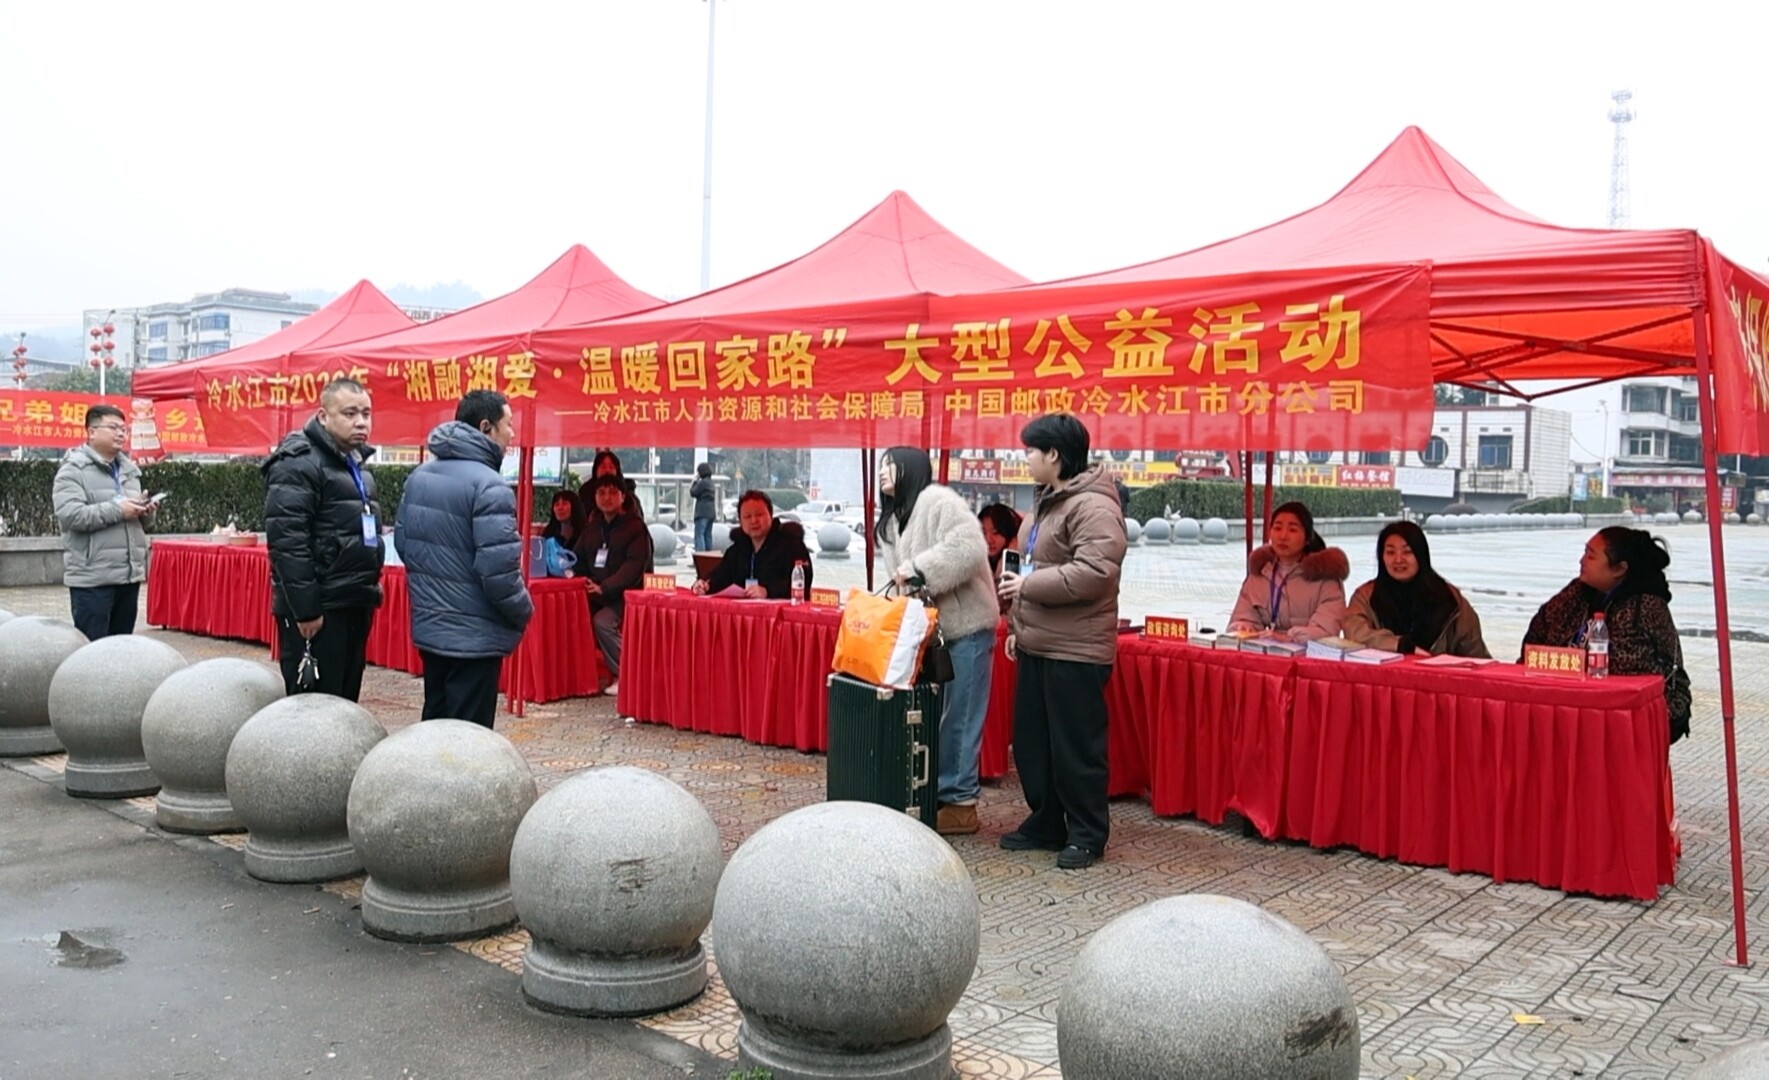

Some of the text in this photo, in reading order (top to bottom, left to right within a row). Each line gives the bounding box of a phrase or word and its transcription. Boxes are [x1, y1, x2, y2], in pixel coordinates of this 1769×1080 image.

[884, 294, 1362, 386] 大型公益活动
[945, 379, 1364, 420] 中国邮政冷水江市分公司
[1527, 650, 1582, 672] 资料发放处
